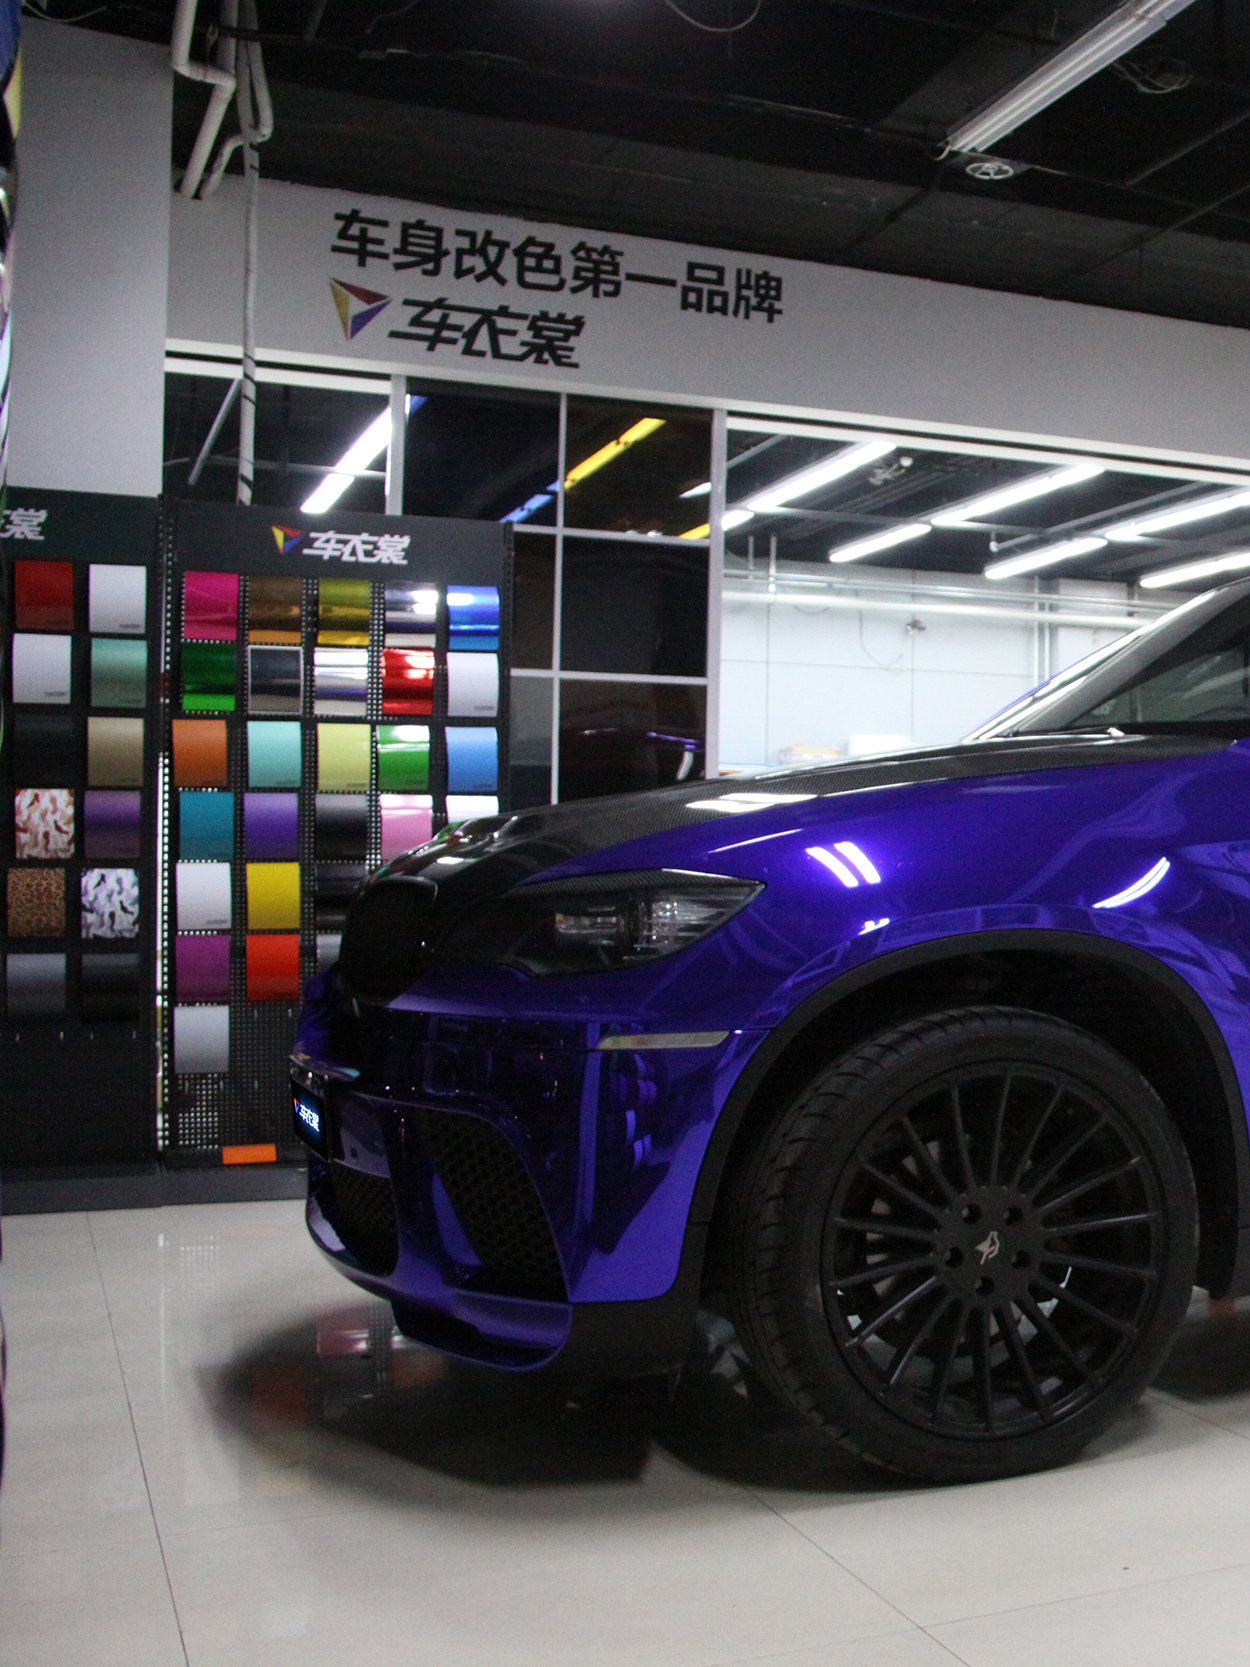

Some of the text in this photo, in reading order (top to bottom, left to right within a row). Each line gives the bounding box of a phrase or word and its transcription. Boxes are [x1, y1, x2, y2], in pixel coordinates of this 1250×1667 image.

[330, 208, 783, 323] 车身改色第一品牌
[388, 297, 585, 368] 车衣裳
[0, 508, 47, 541] 裳
[302, 529, 411, 566] 车衣裳
